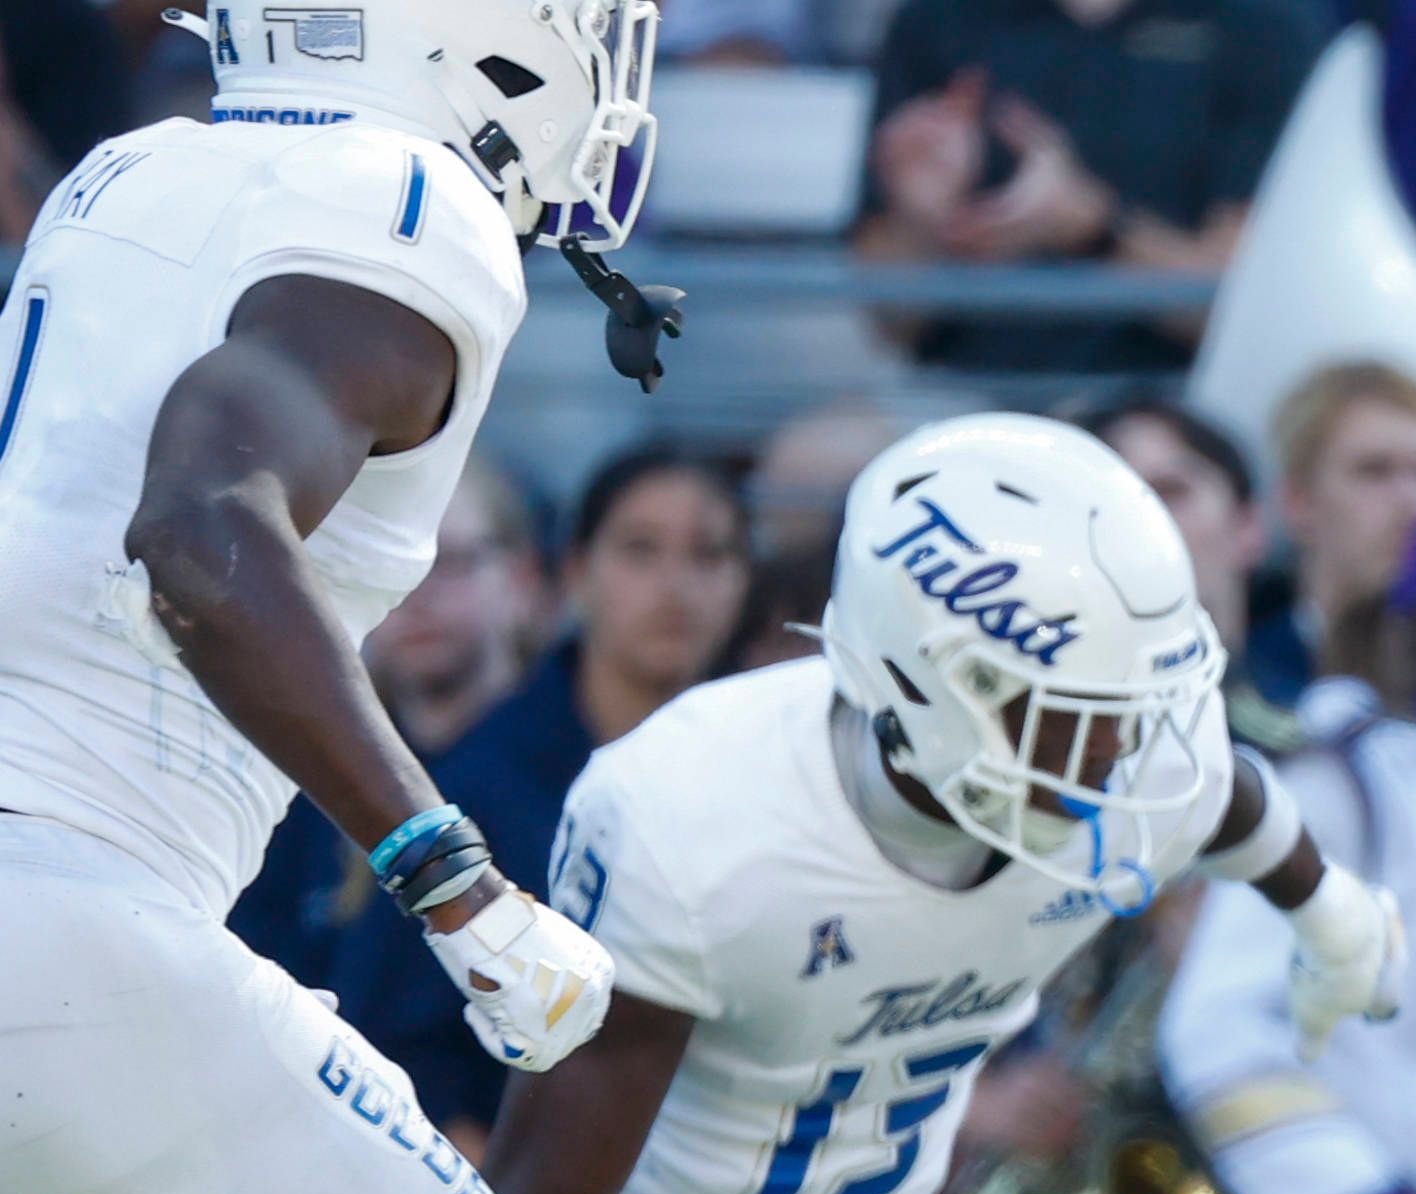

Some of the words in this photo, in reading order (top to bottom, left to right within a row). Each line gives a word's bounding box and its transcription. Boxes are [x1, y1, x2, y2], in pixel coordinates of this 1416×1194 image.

[397, 152, 426, 238] 1
[872, 496, 1082, 666] Tulsa
[834, 969, 1029, 1046] Tulsa
